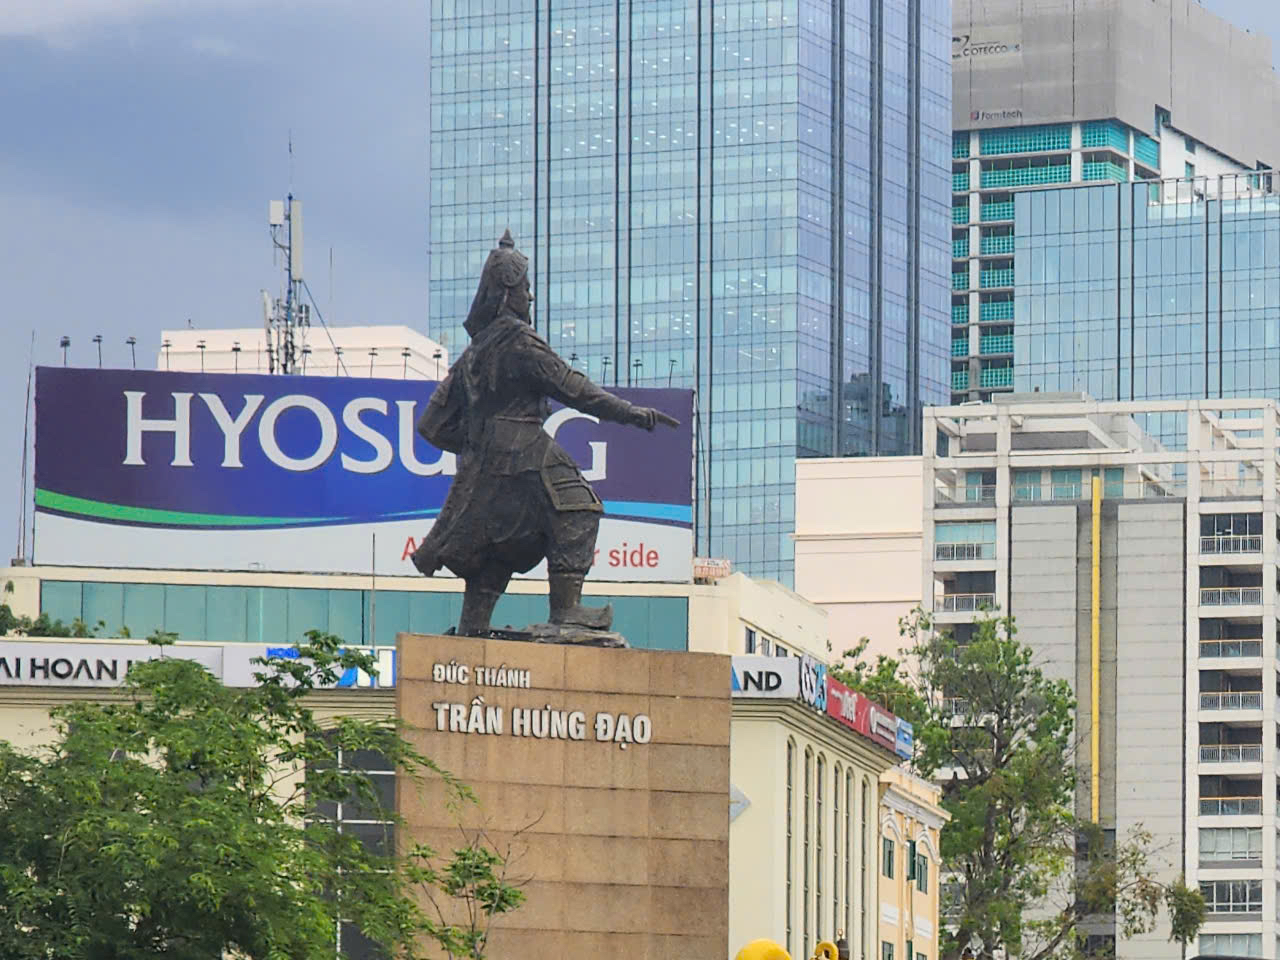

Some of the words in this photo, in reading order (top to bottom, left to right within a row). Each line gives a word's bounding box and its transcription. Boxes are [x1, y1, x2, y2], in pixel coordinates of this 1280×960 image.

[123, 390, 607, 483] HYOSUG
[608, 542, 659, 568] side
[432, 661, 469, 684] ĐỨC
[474, 664, 531, 688] THÁNH
[433, 696, 503, 734] TRẦN
[512, 705, 586, 740] HƯNG
[594, 712, 652, 749] ĐẠO
